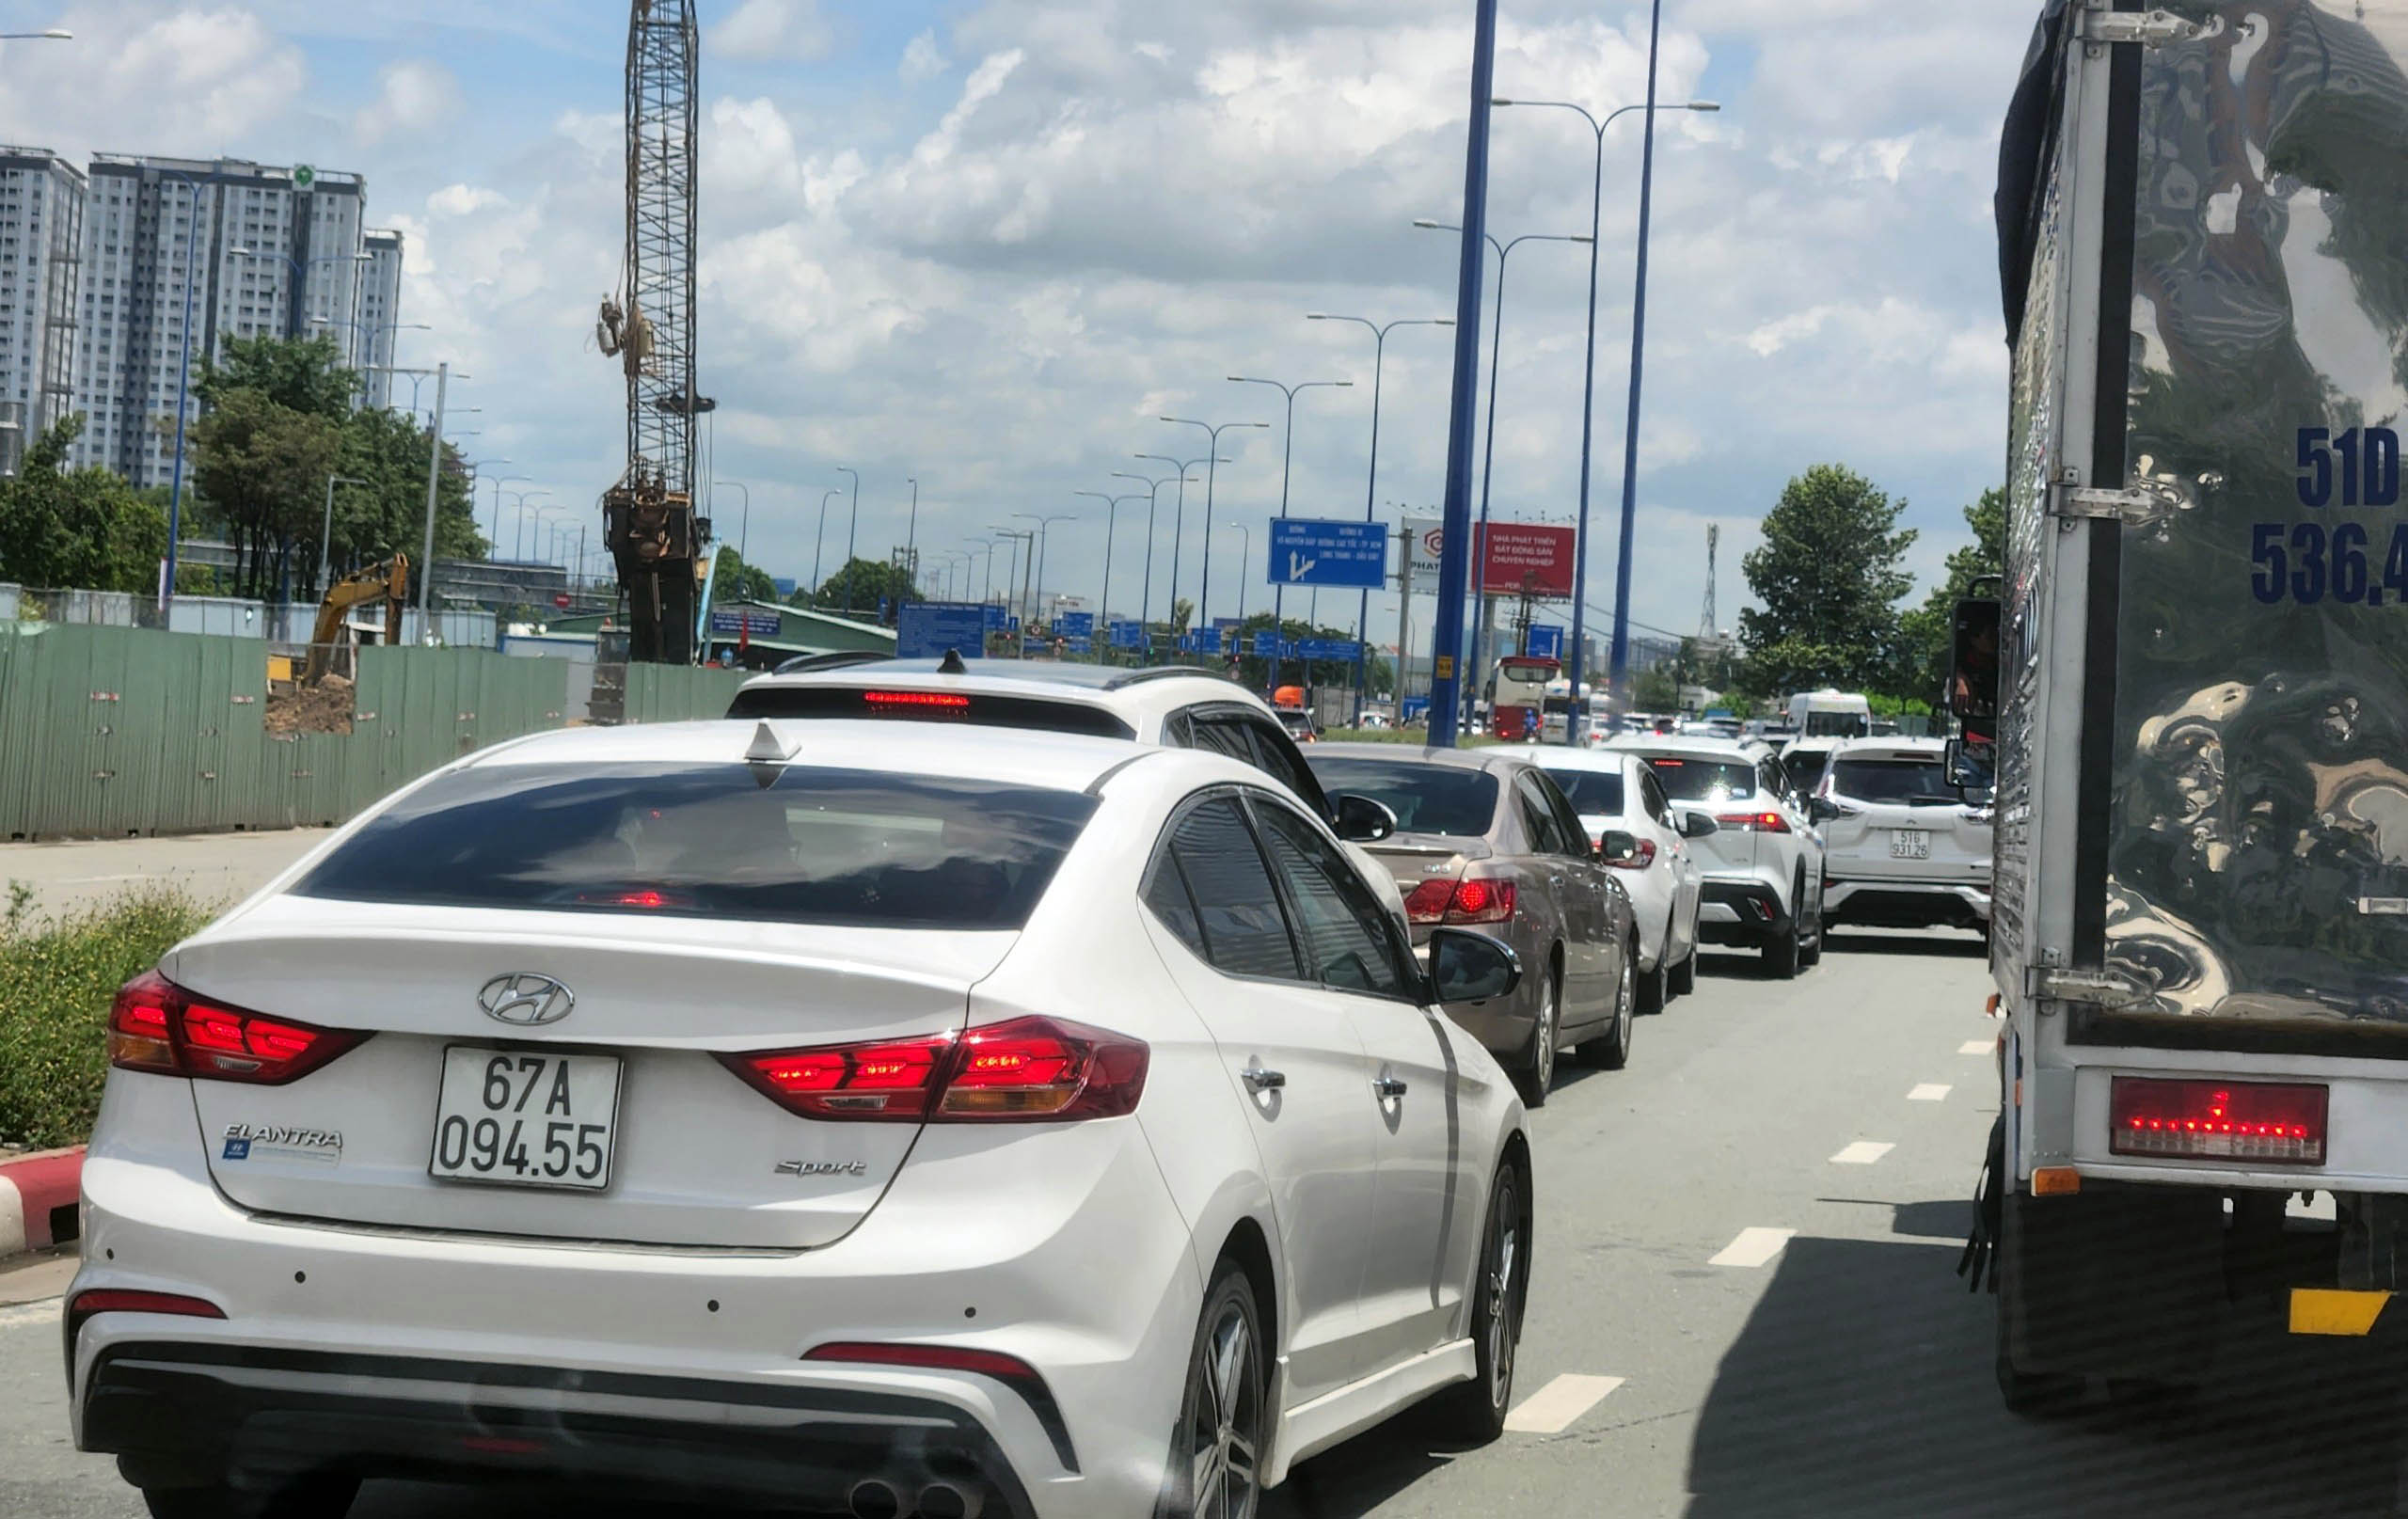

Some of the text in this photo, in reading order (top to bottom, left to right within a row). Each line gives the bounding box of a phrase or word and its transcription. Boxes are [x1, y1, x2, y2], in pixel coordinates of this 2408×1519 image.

[2296, 427, 2399, 508] 51D
[2251, 522, 2408, 607] 536.4
[1893, 844, 1927, 856] 93126
[483, 1056, 571, 1116] 67A
[223, 1123, 343, 1149] ELANTRA
[439, 1115, 607, 1179] 094.55
[774, 1159, 867, 1179] Sport
